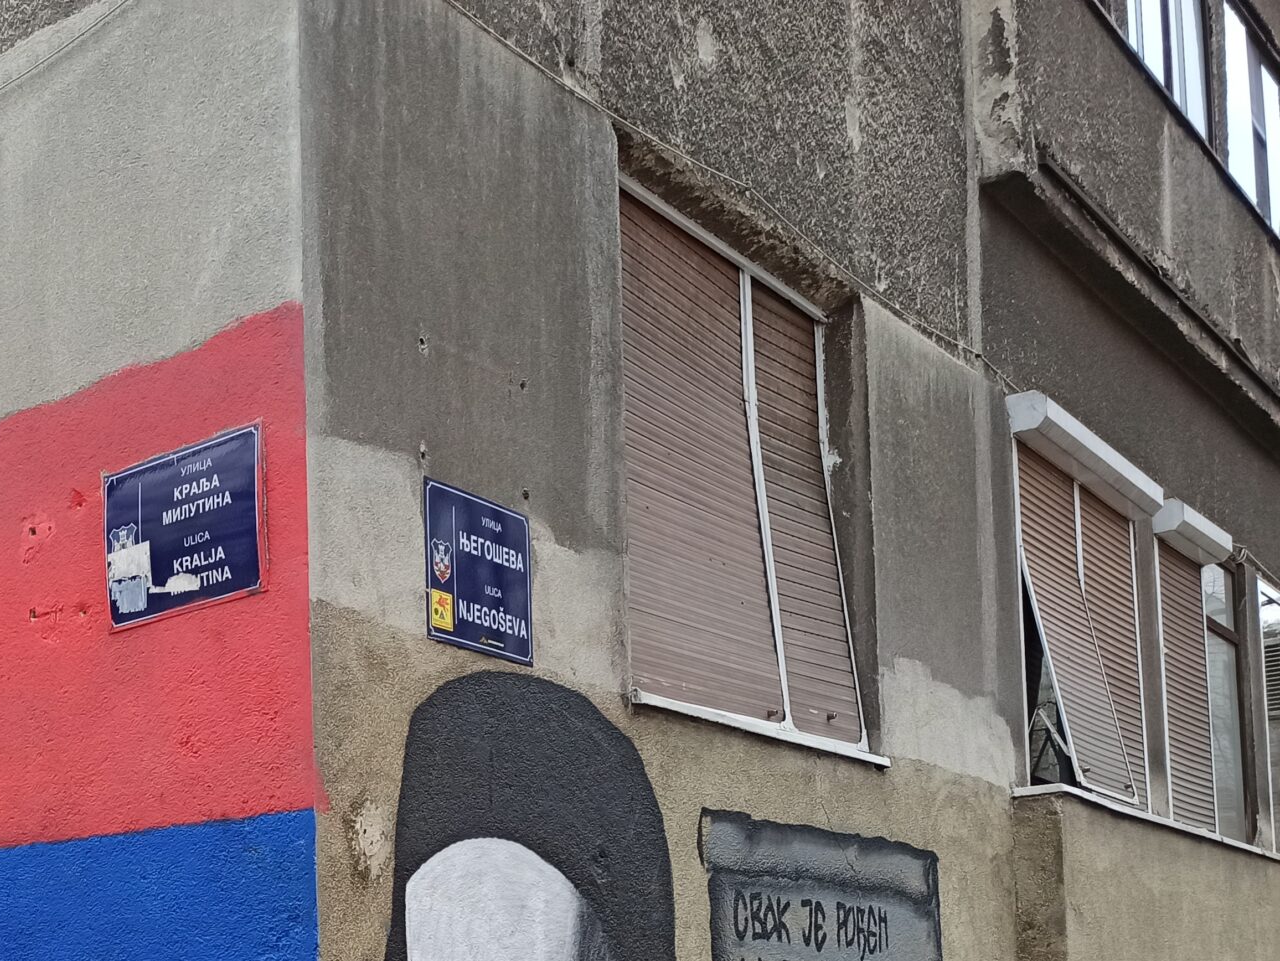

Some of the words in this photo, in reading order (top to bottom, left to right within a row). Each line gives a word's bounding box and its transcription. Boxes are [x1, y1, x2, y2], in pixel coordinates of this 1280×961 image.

[180, 457, 212, 477] УЛИЦА
[173, 473, 220, 502] КРАЉА
[162, 490, 232, 526] МИЛУТИНА
[183, 530, 210, 547] ULICA
[481, 516, 502, 533] УЛИЦА
[173, 546, 225, 574] KRALJA
[459, 530, 524, 573] ЊЕГОШЕВА
[484, 584, 502, 599] ULICA
[459, 598, 528, 640] NJEGOŠEVA
[801, 898, 827, 952] ЈЕ
